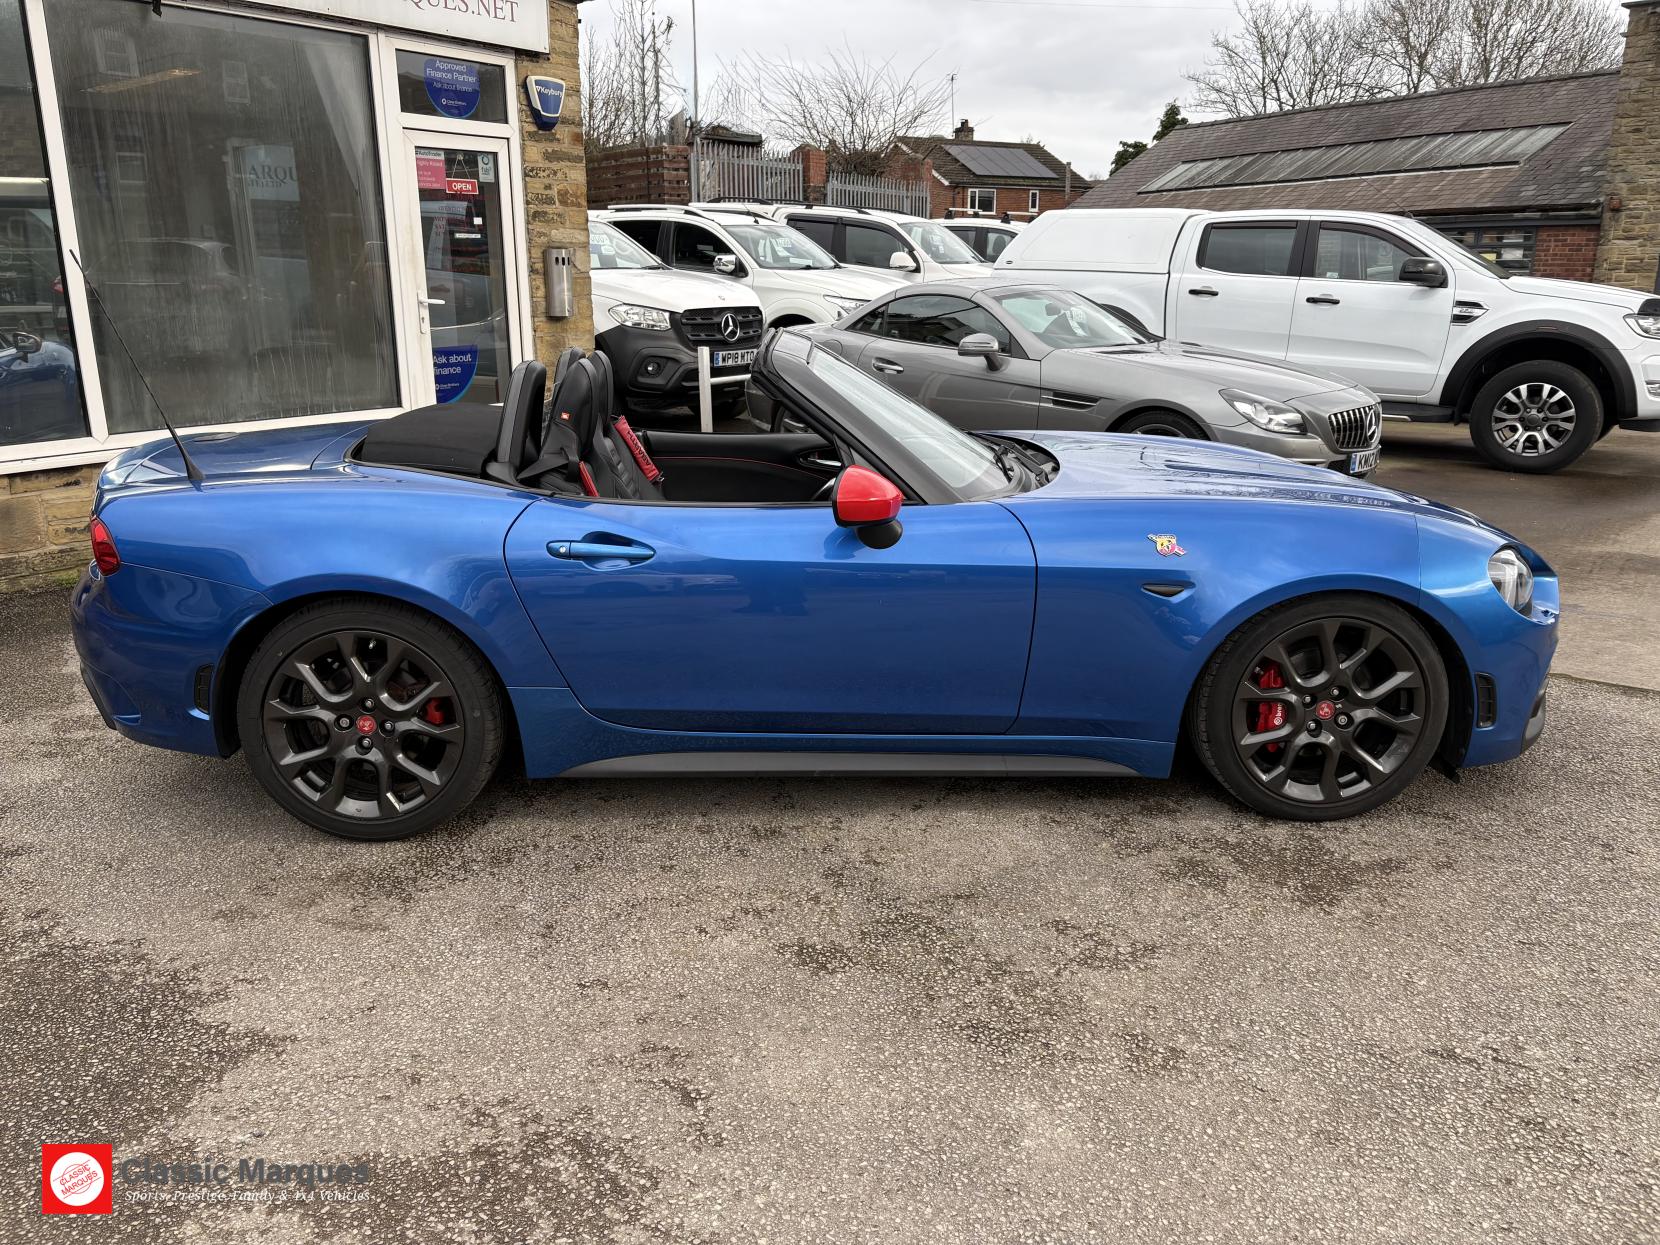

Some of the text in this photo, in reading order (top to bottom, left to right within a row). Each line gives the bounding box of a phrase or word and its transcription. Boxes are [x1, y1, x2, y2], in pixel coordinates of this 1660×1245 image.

[435, 60, 467, 72] Approved
[426, 68, 477, 83] Finance Partner
[451, 182, 472, 191] OPEN
[433, 353, 472, 364] Ask about
[721, 352, 739, 364] WP18
